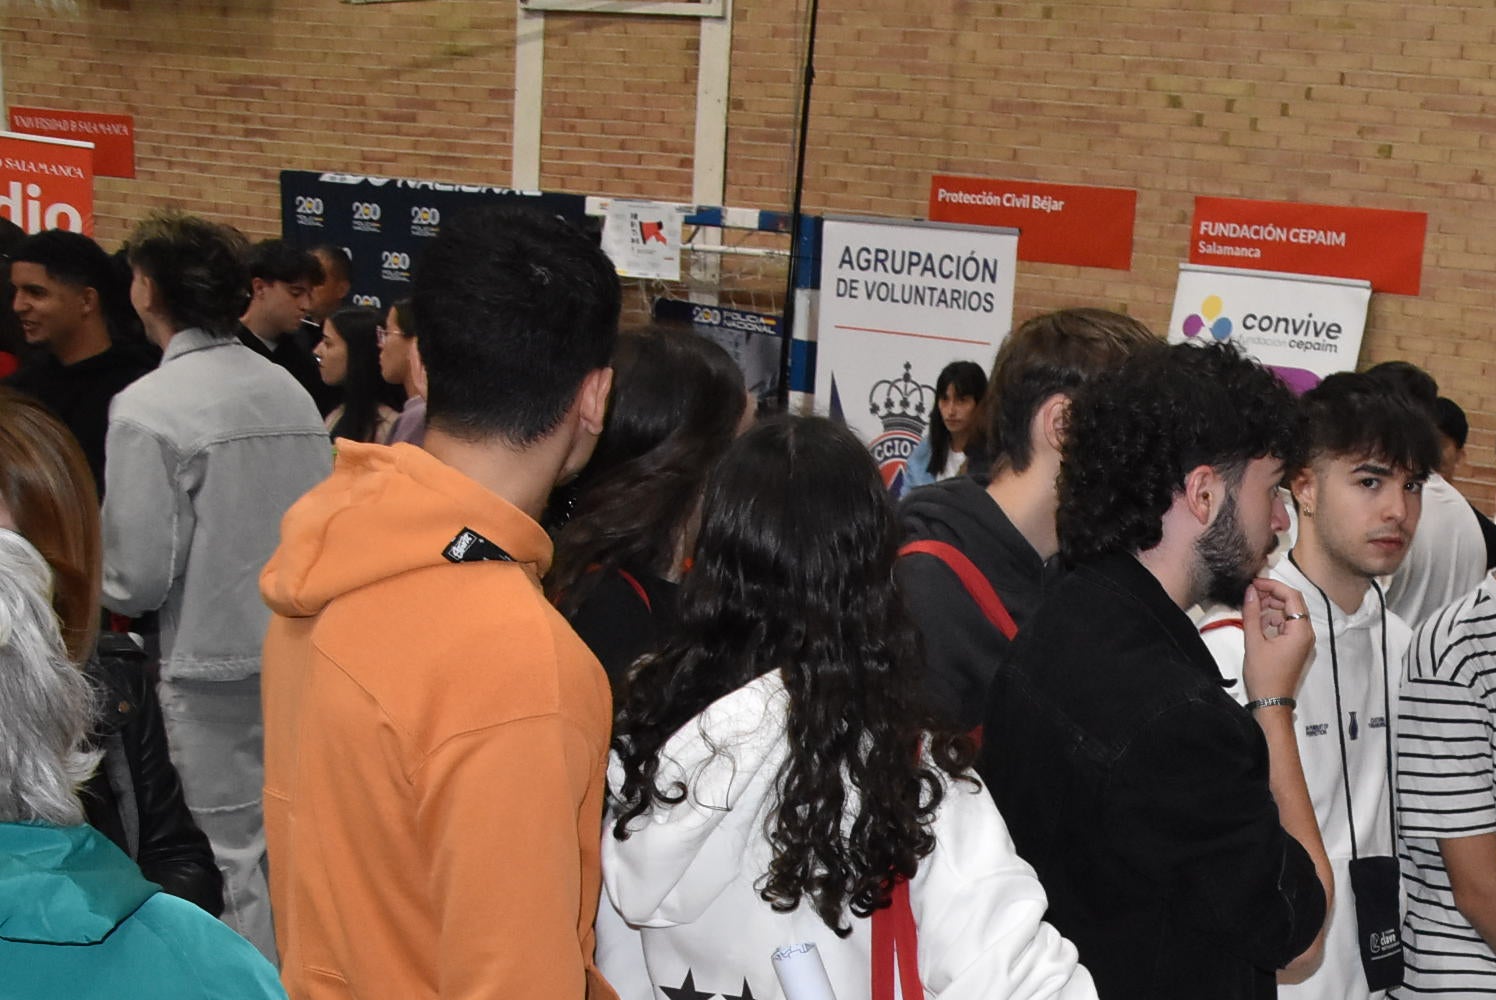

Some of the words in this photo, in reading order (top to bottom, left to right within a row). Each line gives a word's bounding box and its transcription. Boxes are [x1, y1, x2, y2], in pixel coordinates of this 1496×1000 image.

[4, 158, 85, 178] SALAMANCA
[938, 188, 1001, 207] Protección
[1003, 192, 1030, 209] Civil
[1032, 197, 1064, 214] Béjar
[1200, 221, 1286, 243] FUNDACIÓN
[1289, 228, 1345, 247] CEPAIM
[1198, 241, 1261, 259] Salamanca
[838, 245, 998, 284] AGRUPACIÓN
[836, 278, 858, 299] DE
[864, 280, 995, 313] VOLUNTARIOS
[1242, 313, 1342, 340] convive
[1289, 338, 1338, 354] cepaim
